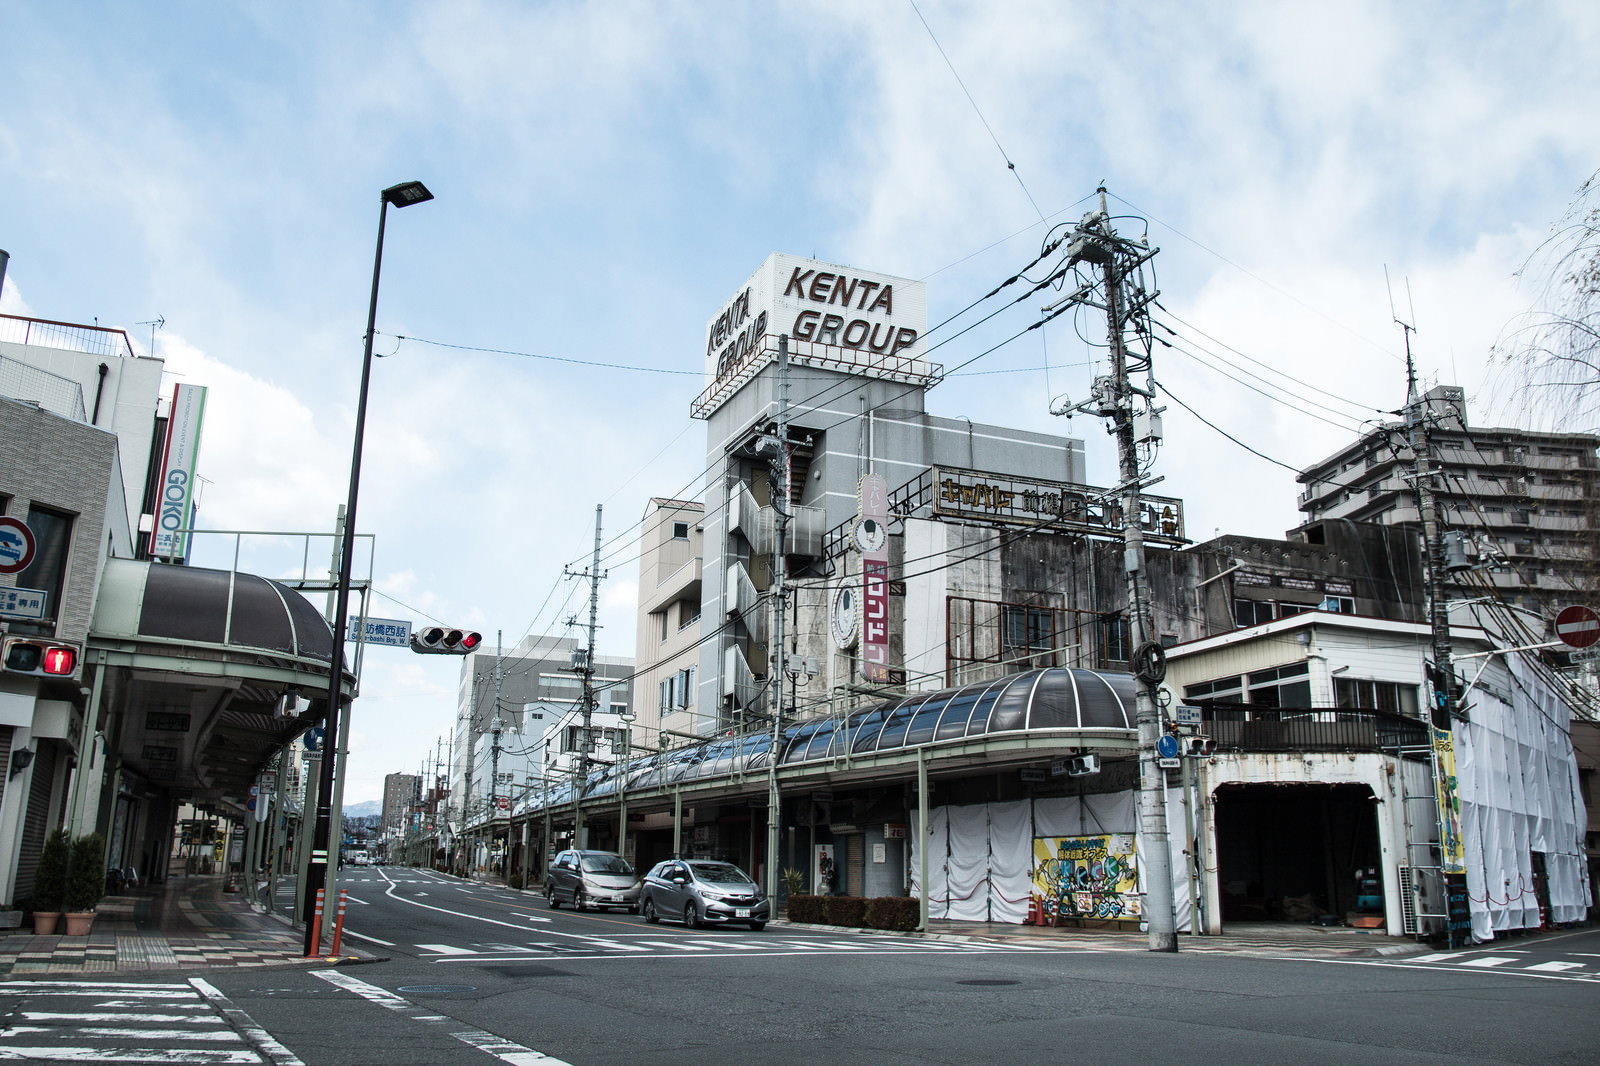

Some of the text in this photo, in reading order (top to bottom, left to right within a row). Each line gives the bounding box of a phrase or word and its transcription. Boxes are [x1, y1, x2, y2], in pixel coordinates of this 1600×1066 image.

[784, 266, 893, 315] KENTA
[706, 286, 752, 356] KENTA
[716, 310, 768, 382] GROUP
[792, 309, 918, 357] GROUP
[161, 469, 188, 530] GOKO
[868, 477, 880, 516] キャバレー
[941, 478, 1015, 508] キャバレー
[868, 576, 884, 664] ロンドン
